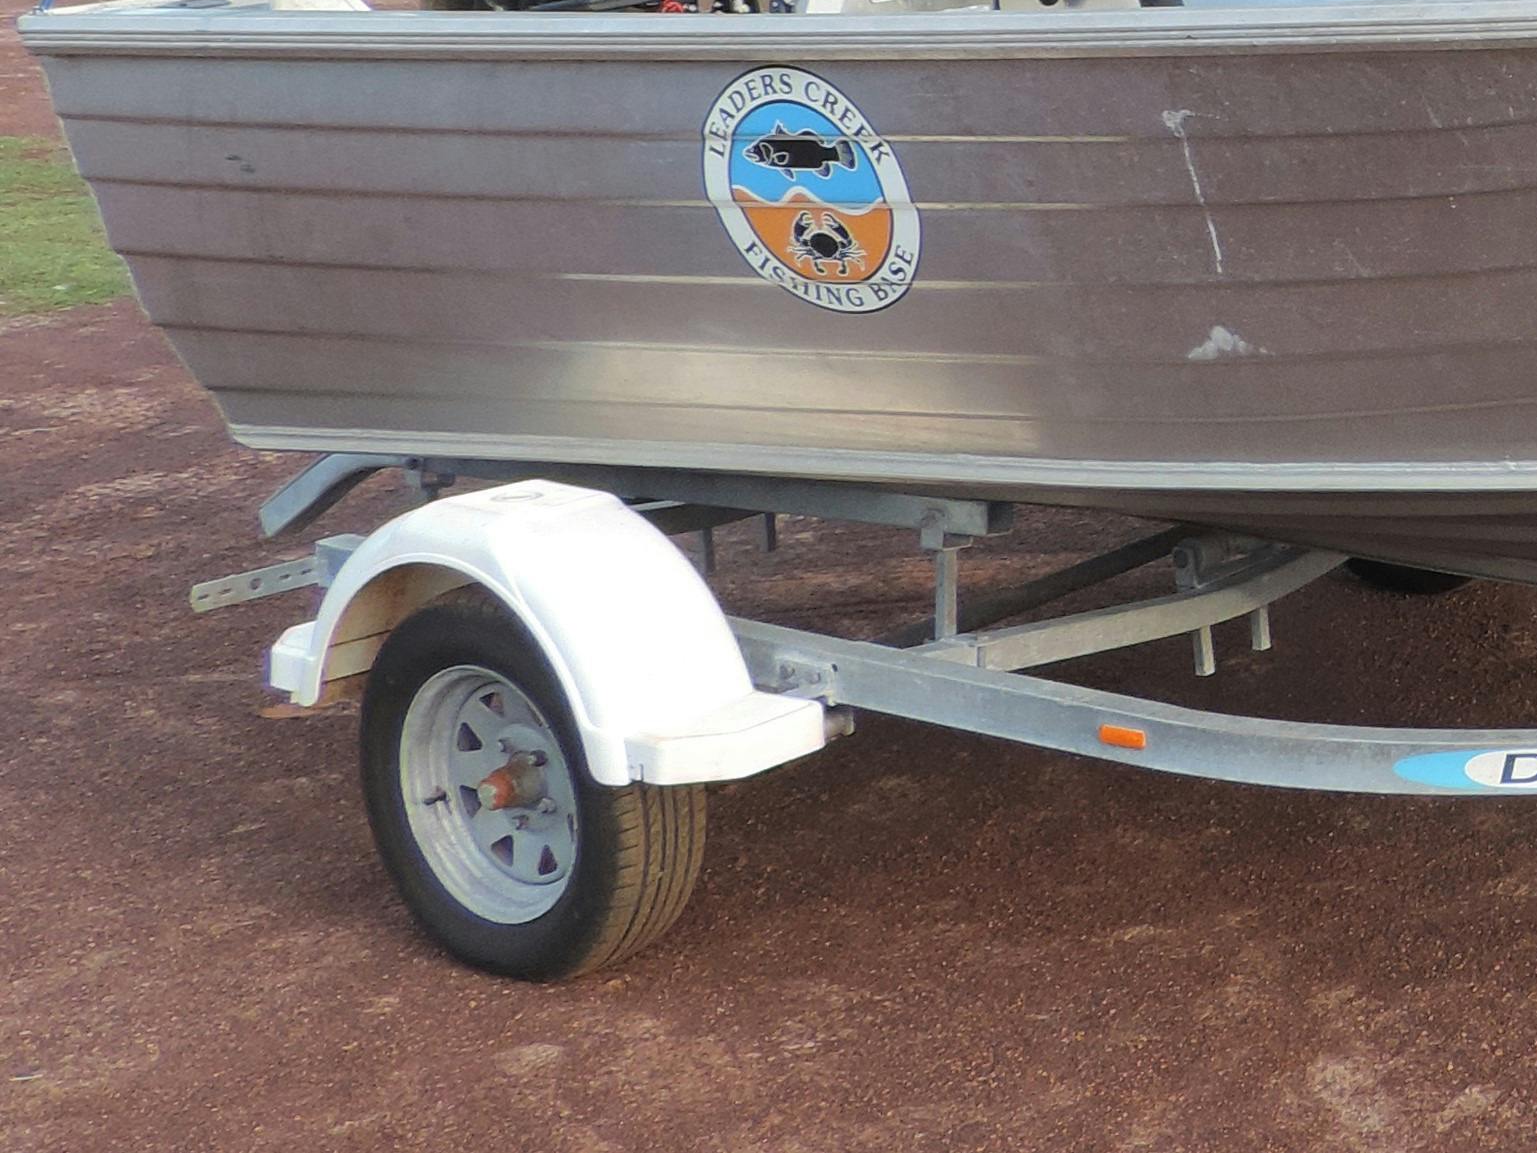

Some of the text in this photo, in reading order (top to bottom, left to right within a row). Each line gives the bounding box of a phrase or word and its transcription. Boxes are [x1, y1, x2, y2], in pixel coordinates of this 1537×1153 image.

[708, 73, 892, 165] LEADERS CREEK
[745, 241, 915, 307] FISHING BASE
